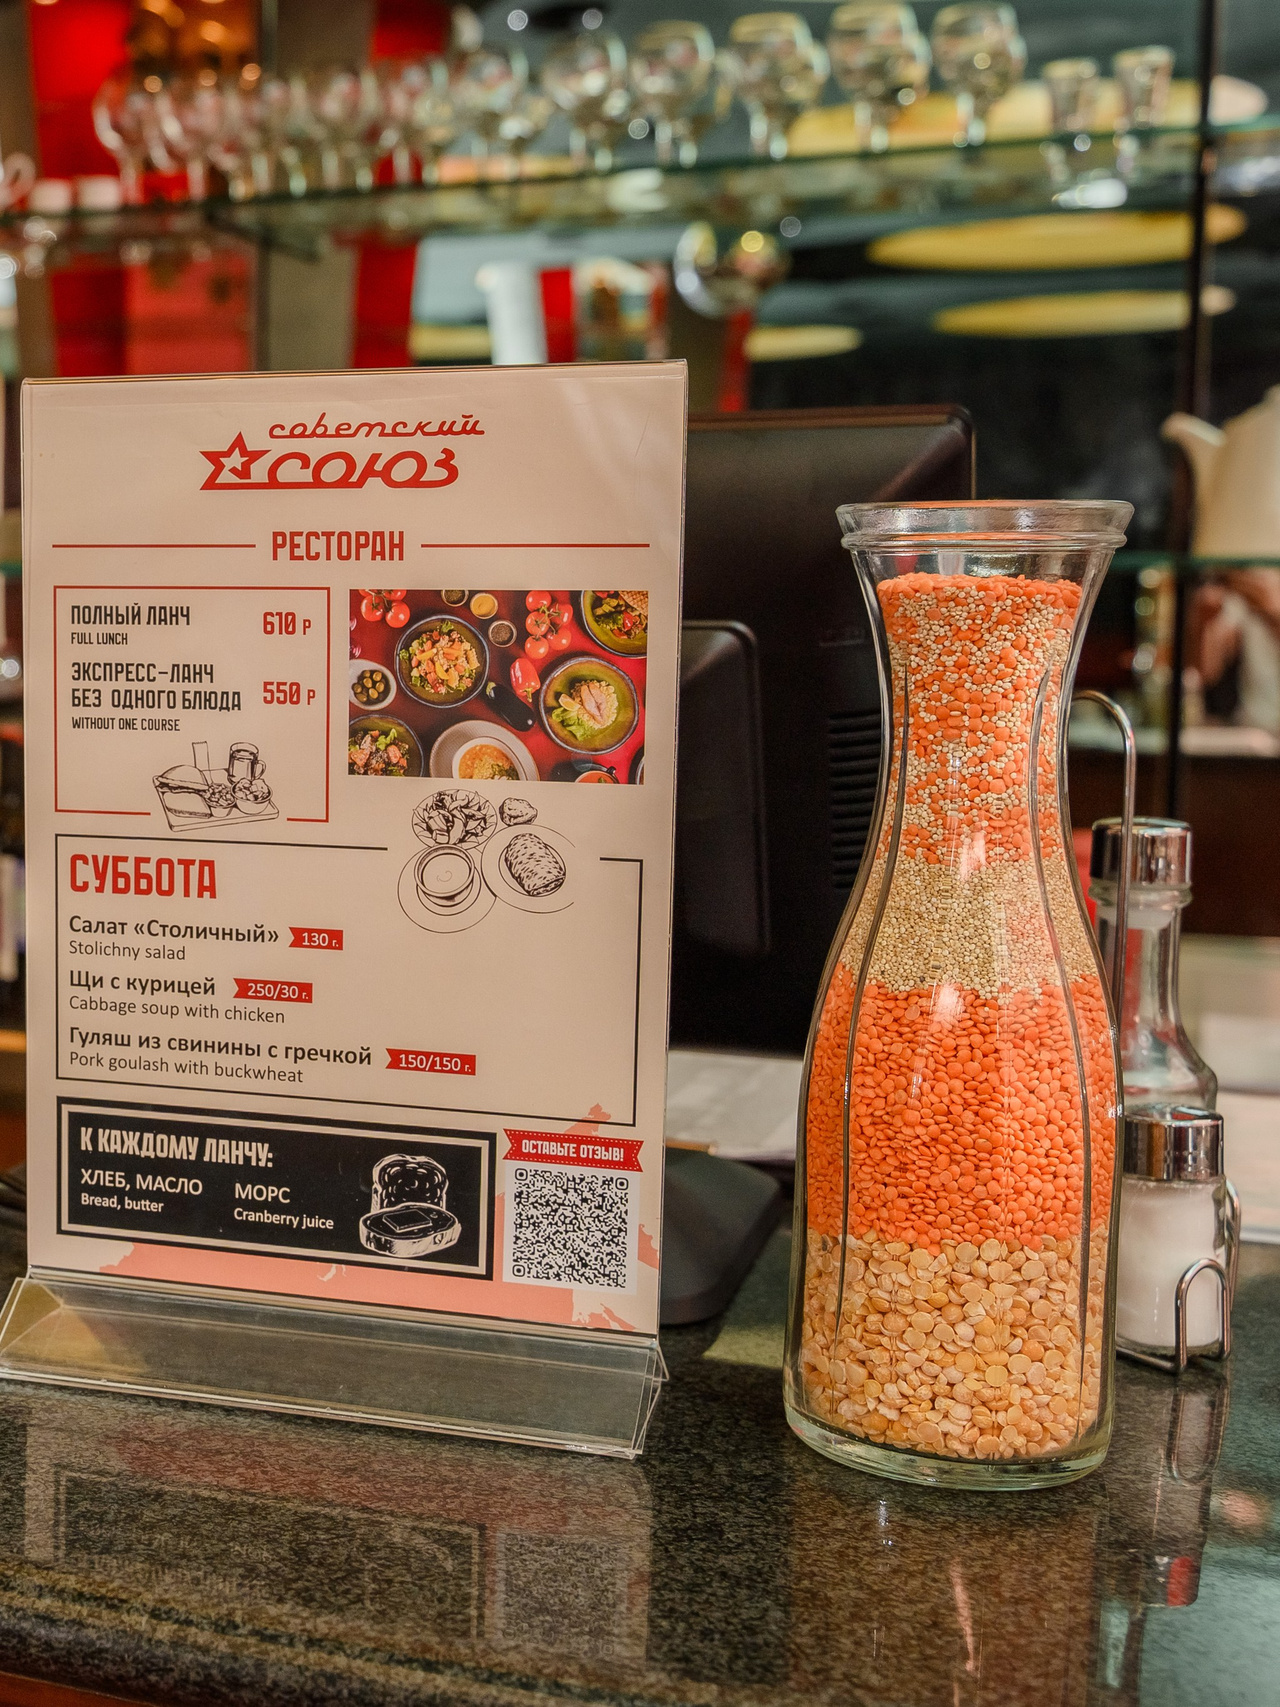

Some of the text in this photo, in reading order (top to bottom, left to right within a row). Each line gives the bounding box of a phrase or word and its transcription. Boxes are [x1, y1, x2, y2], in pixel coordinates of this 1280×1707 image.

[272, 531, 404, 561] РЕСТОРАН
[71, 603, 190, 626] ПОЛНЫЙ ЛАНЧ
[263, 612, 296, 635] 610
[71, 632, 128, 645] FULL LUNCH
[72, 688, 242, 712] БЕЗ ОДНОГО БЛЮДА
[263, 681, 301, 705] 550
[71, 716, 180, 732] WITHOUT ONE COURSE
[70, 853, 217, 899] СУББОТА
[69, 915, 279, 943] Салат «Столичный»
[302, 932, 329, 947] 130
[69, 940, 186, 961] Stolichny salad
[70, 970, 215, 998] Щи с курицей
[247, 983, 299, 1000] 250/30
[70, 995, 285, 1024] Cabbage soup with chicken
[70, 1027, 371, 1065] Гуляш из свинины с гречкой
[70, 1051, 303, 1083] Pork goulash with buckwheat
[399, 1053, 461, 1072] 150/150
[80, 1127, 273, 1168] К КАЖДОМУ ЛАНЧУ:
[522, 1139, 624, 1162] ОСТАВЬТЕ ОТЗЫВ!
[81, 1168, 203, 1195] ХЛЕБ, МАСЛО
[81, 1193, 164, 1212] Bread, butter
[235, 1183, 290, 1204] МОРС
[234, 1208, 334, 1230] Cranberry juice
